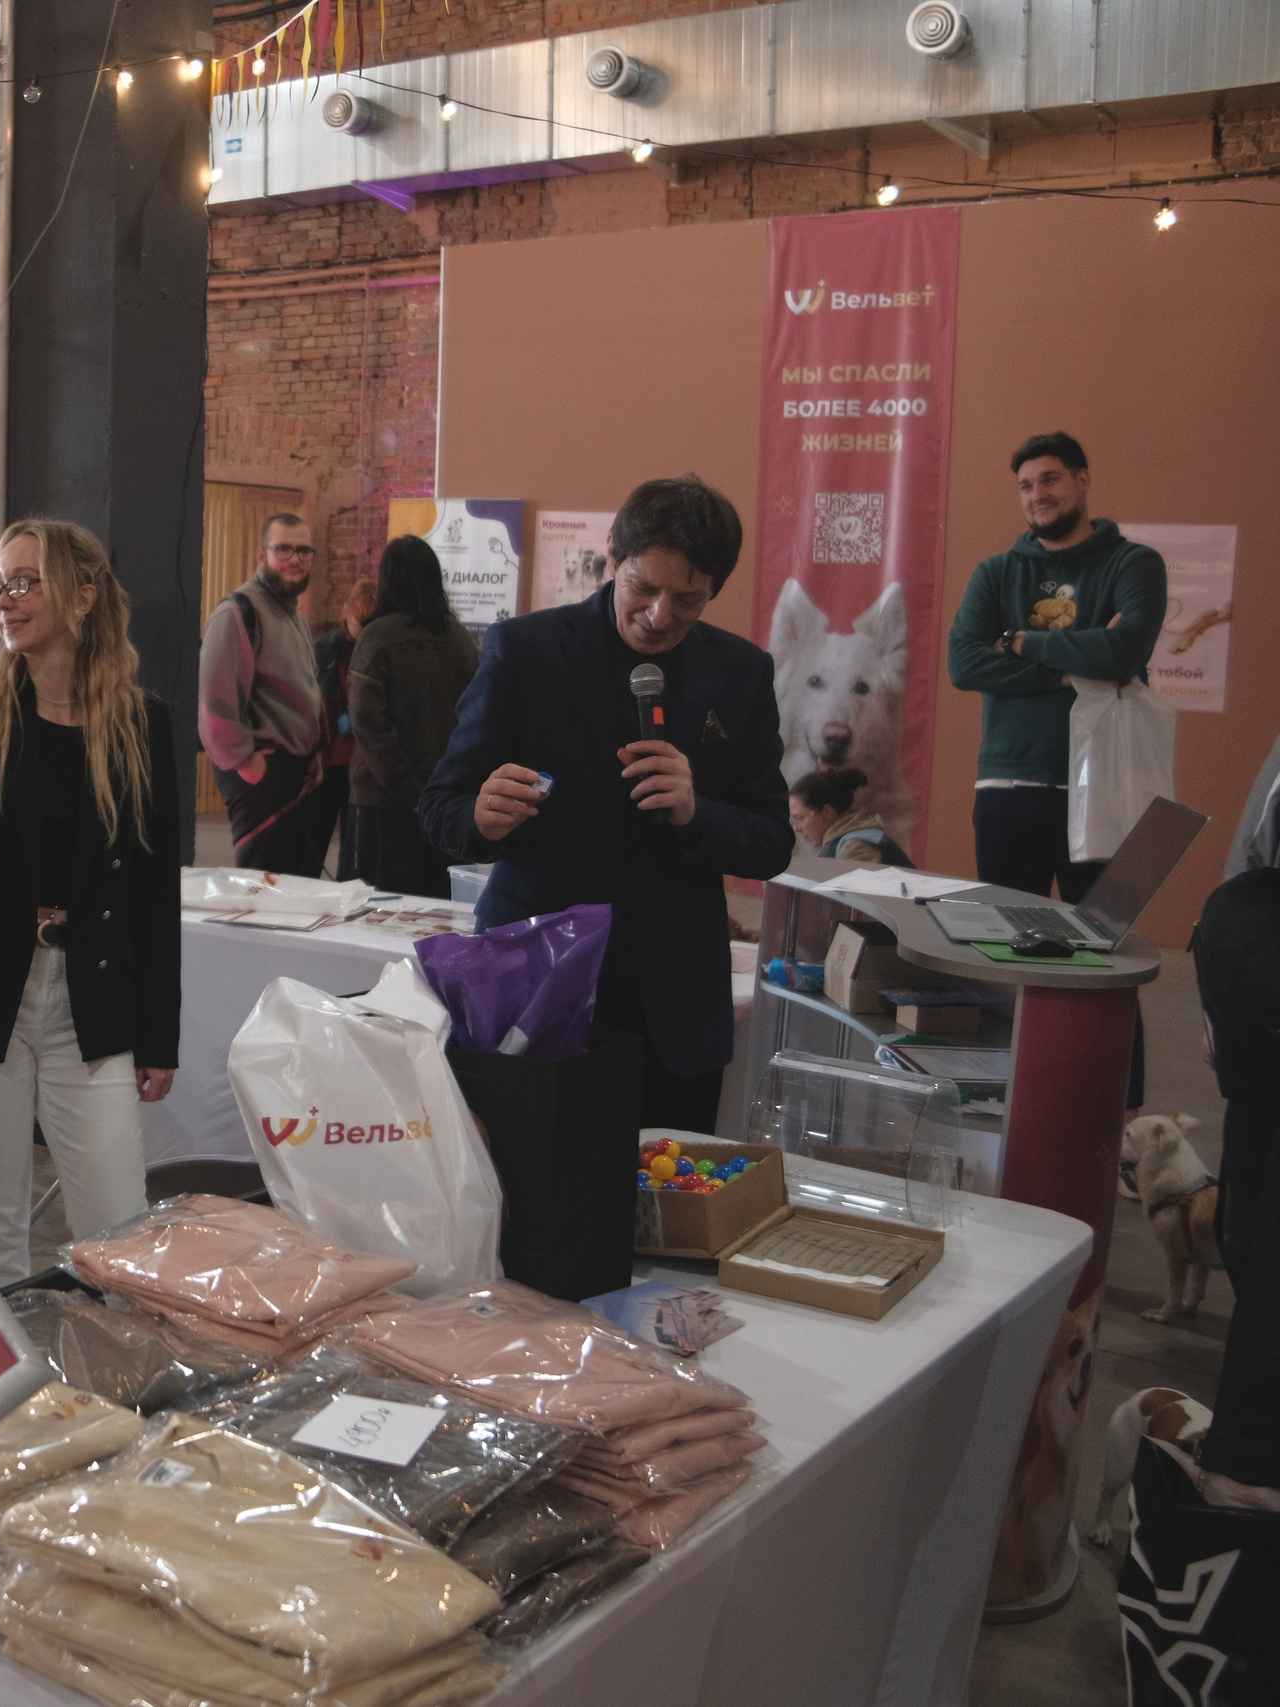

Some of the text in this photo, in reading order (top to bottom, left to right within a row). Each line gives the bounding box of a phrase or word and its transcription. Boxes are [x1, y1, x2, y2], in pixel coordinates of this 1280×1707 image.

[830, 288, 935, 311] Вельвет
[781, 363, 931, 384] МЫ СПАСЛИ
[783, 398, 927, 418] БОЛЕЕ 4000
[801, 429, 903, 451] ЖИЗНЕЙ
[542, 519, 587, 529] Кровные
[451, 571, 508, 584] ДИАЛОГ
[1157, 666, 1204, 679] тобой
